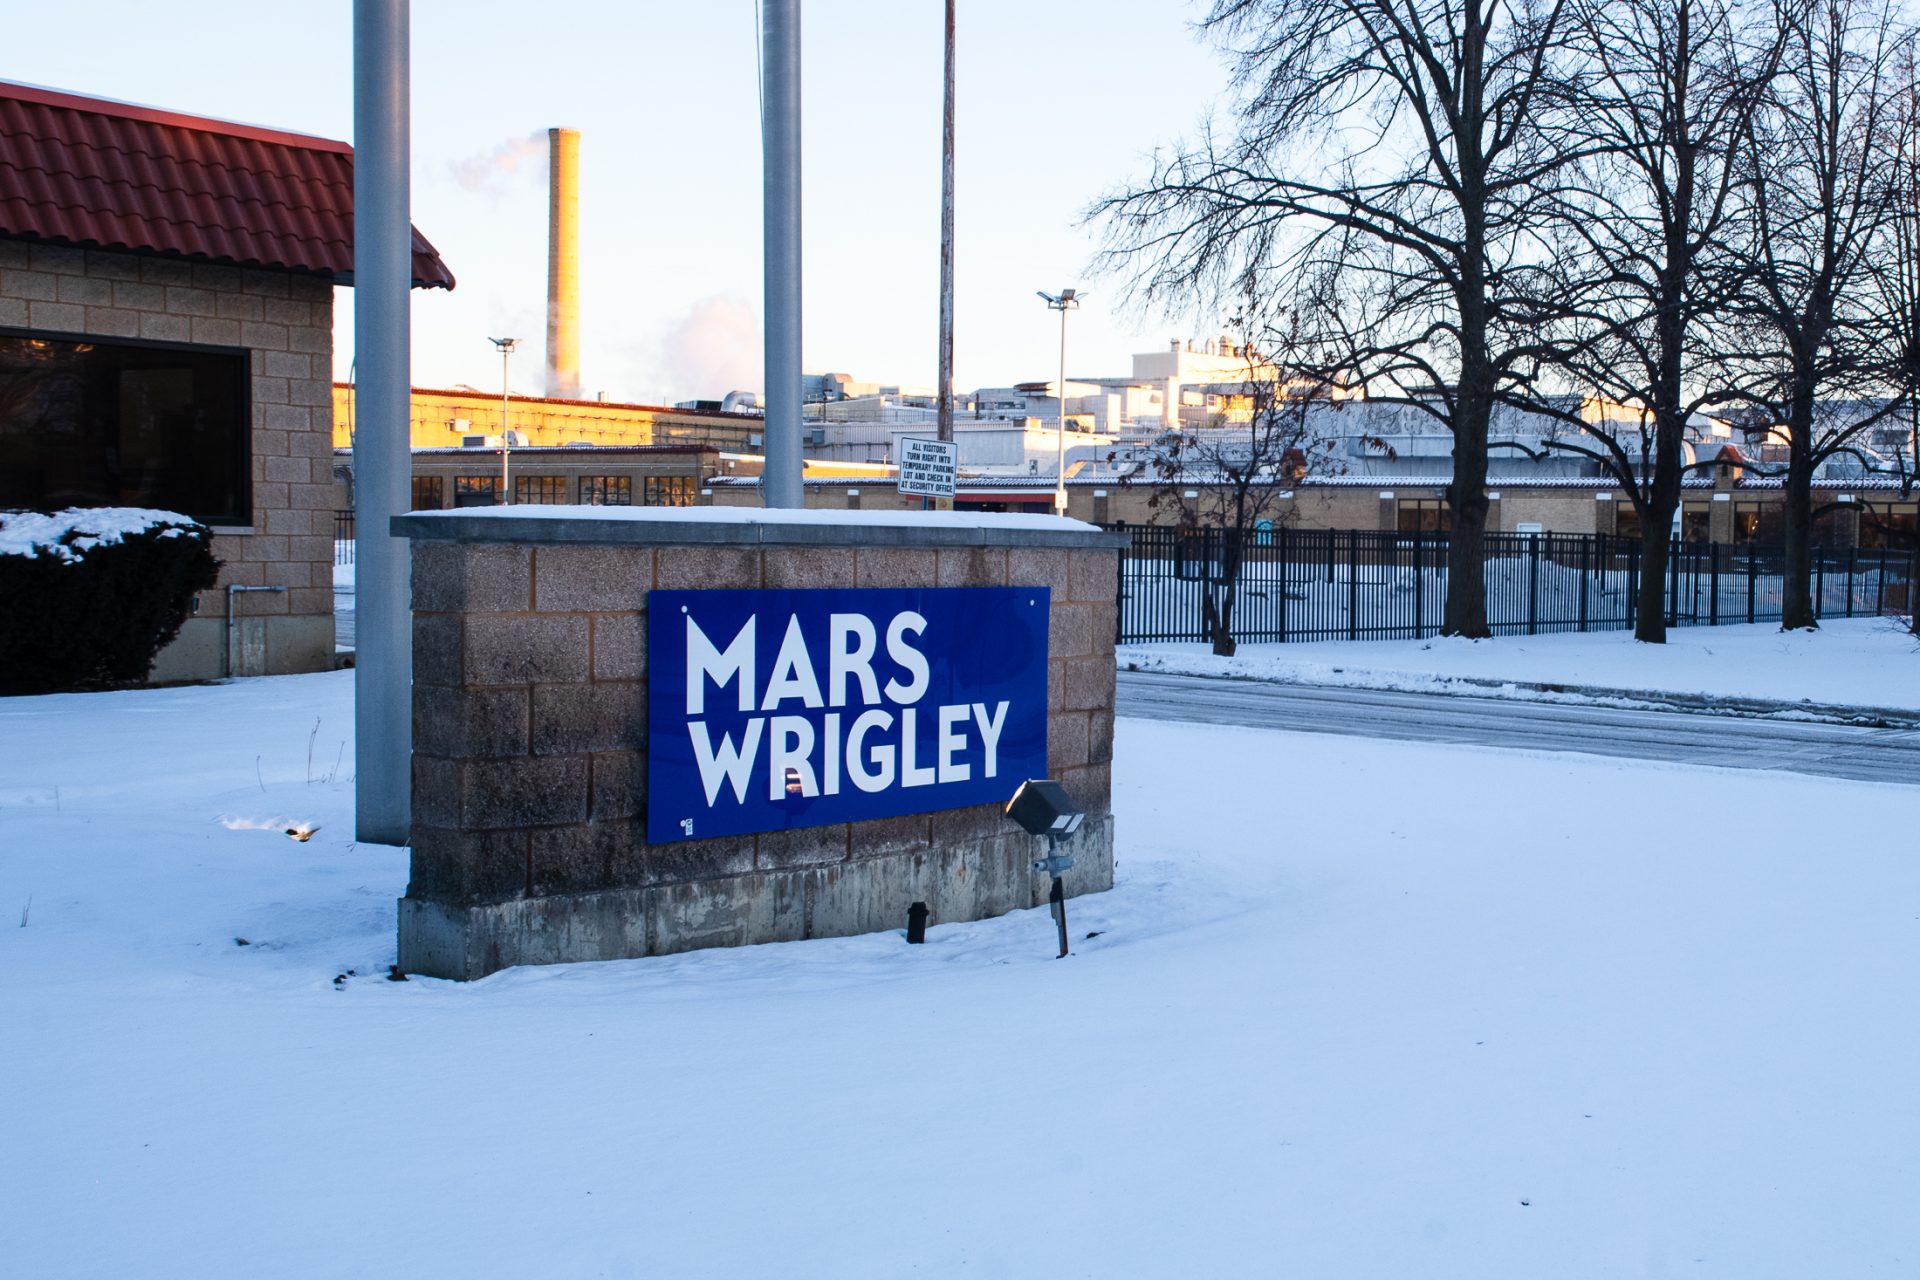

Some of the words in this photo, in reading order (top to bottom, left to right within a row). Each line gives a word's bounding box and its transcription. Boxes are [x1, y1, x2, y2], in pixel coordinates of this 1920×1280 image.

[912, 443, 921, 451] ALL
[923, 444, 946, 454] VISITORS
[907, 452, 920, 460] TURN
[903, 462, 931, 471] TEMPORARY
[933, 465, 954, 474] PARKING
[910, 482, 934, 491] SECURITY
[936, 484, 952, 492] OFFICE
[686, 610, 930, 715] MARS
[687, 700, 1011, 808] WRIGLEY
